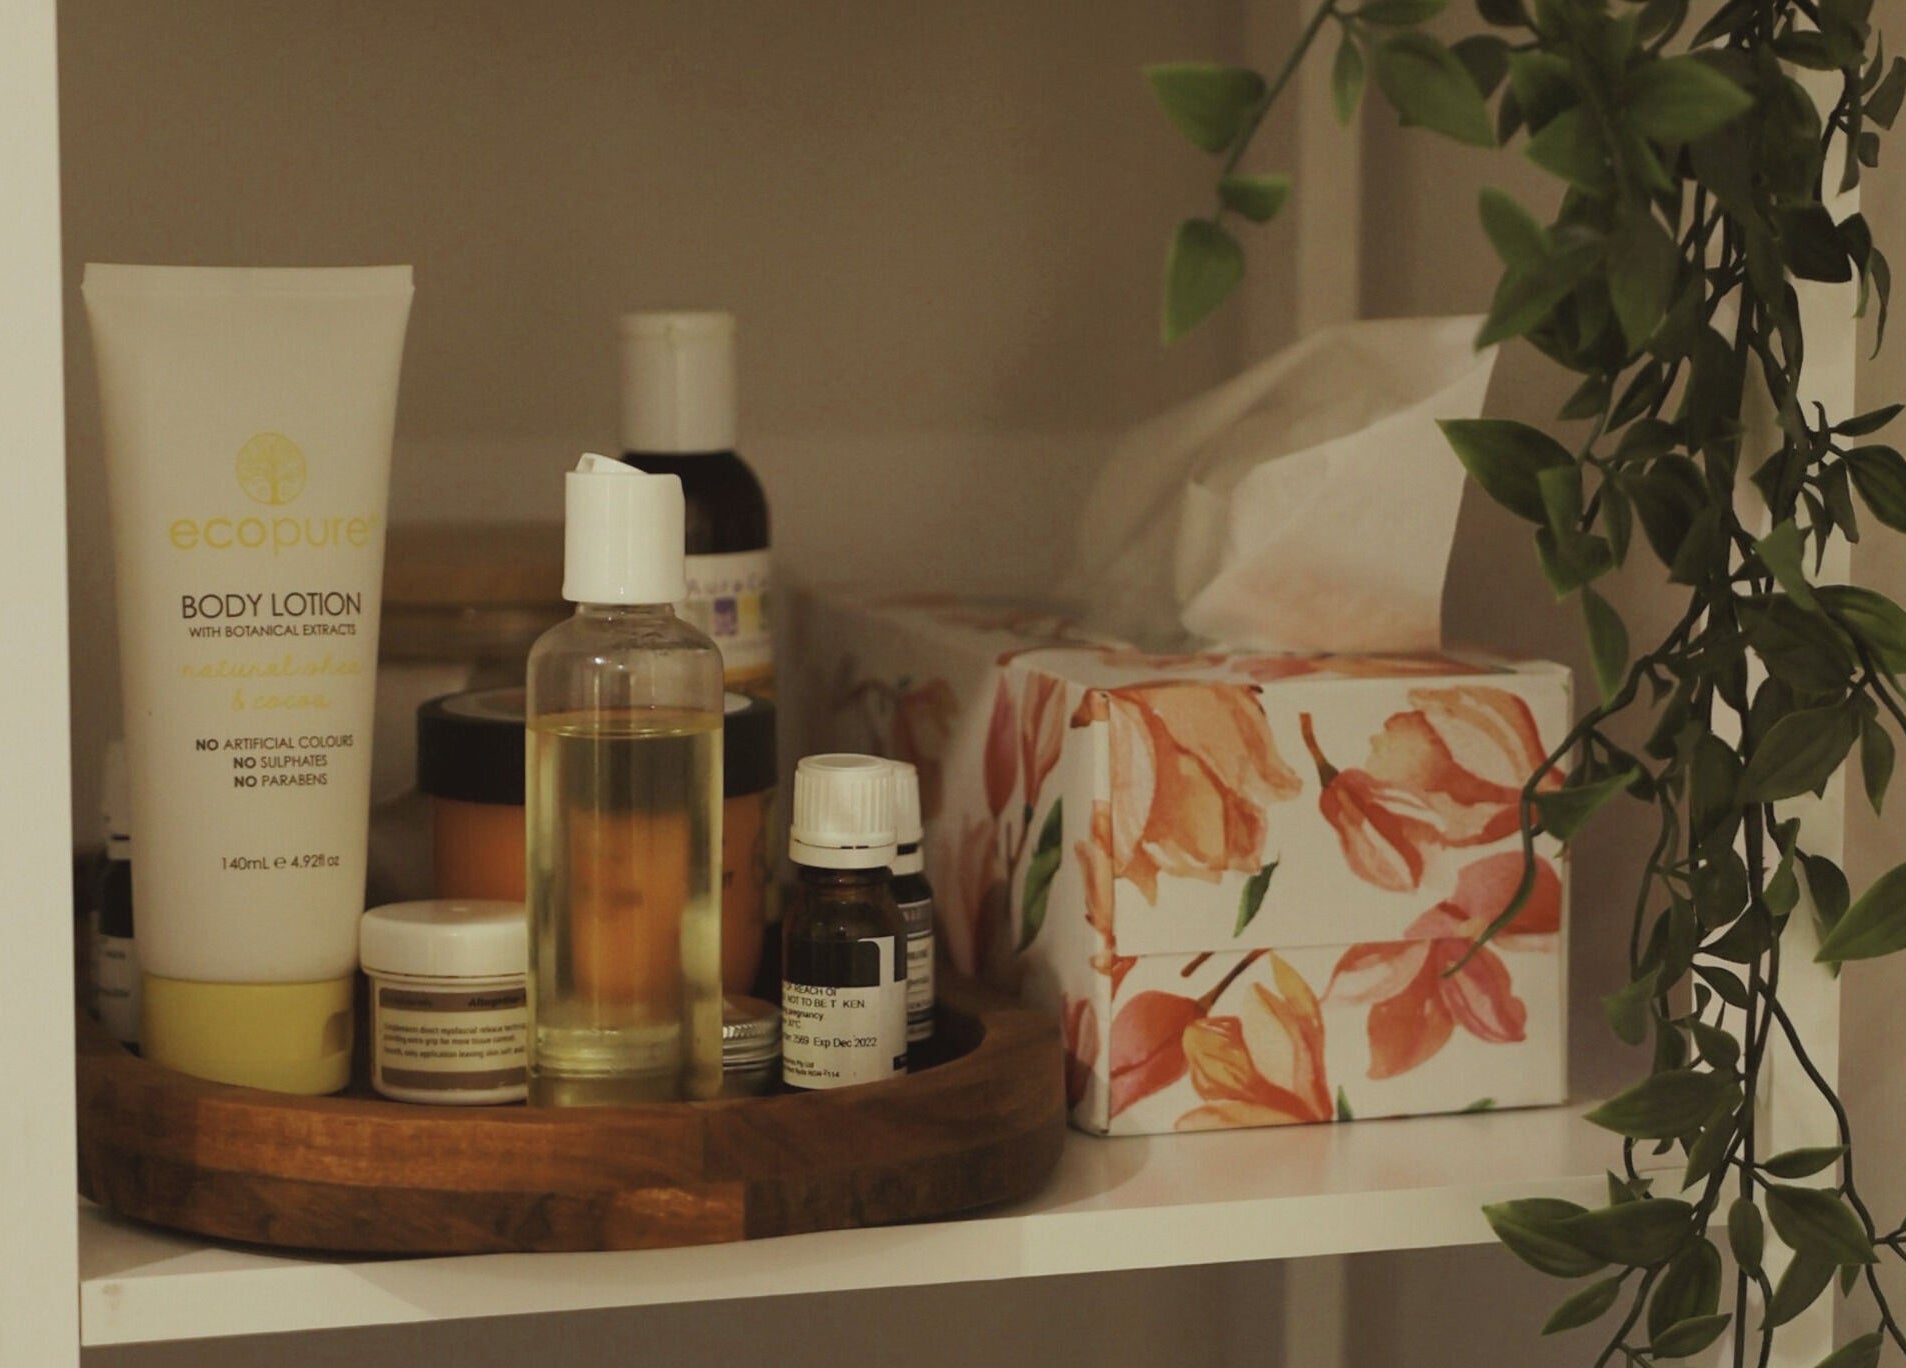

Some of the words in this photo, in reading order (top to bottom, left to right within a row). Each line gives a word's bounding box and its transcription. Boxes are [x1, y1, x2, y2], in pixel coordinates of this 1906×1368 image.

[169, 515, 370, 556] ecopure
[182, 593, 263, 619] BODY
[271, 592, 362, 617] LOTION
[189, 626, 221, 638] WITH
[225, 624, 299, 638] BOTANICAL
[303, 623, 356, 636] EXTRACTS
[196, 738, 219, 751] NO
[223, 736, 295, 751] ARTIFICIAL
[298, 734, 354, 749] COLOURS
[233, 757, 257, 769] NO
[260, 755, 328, 769] SULPHATES
[234, 775, 257, 788] NO
[261, 773, 328, 787] PARABENS
[222, 856, 270, 871] 140mL
[814, 999, 827, 1008] BE
[813, 1037, 831, 1049] Exp
[833, 1037, 852, 1048] Dec
[854, 1036, 878, 1048] 2022
